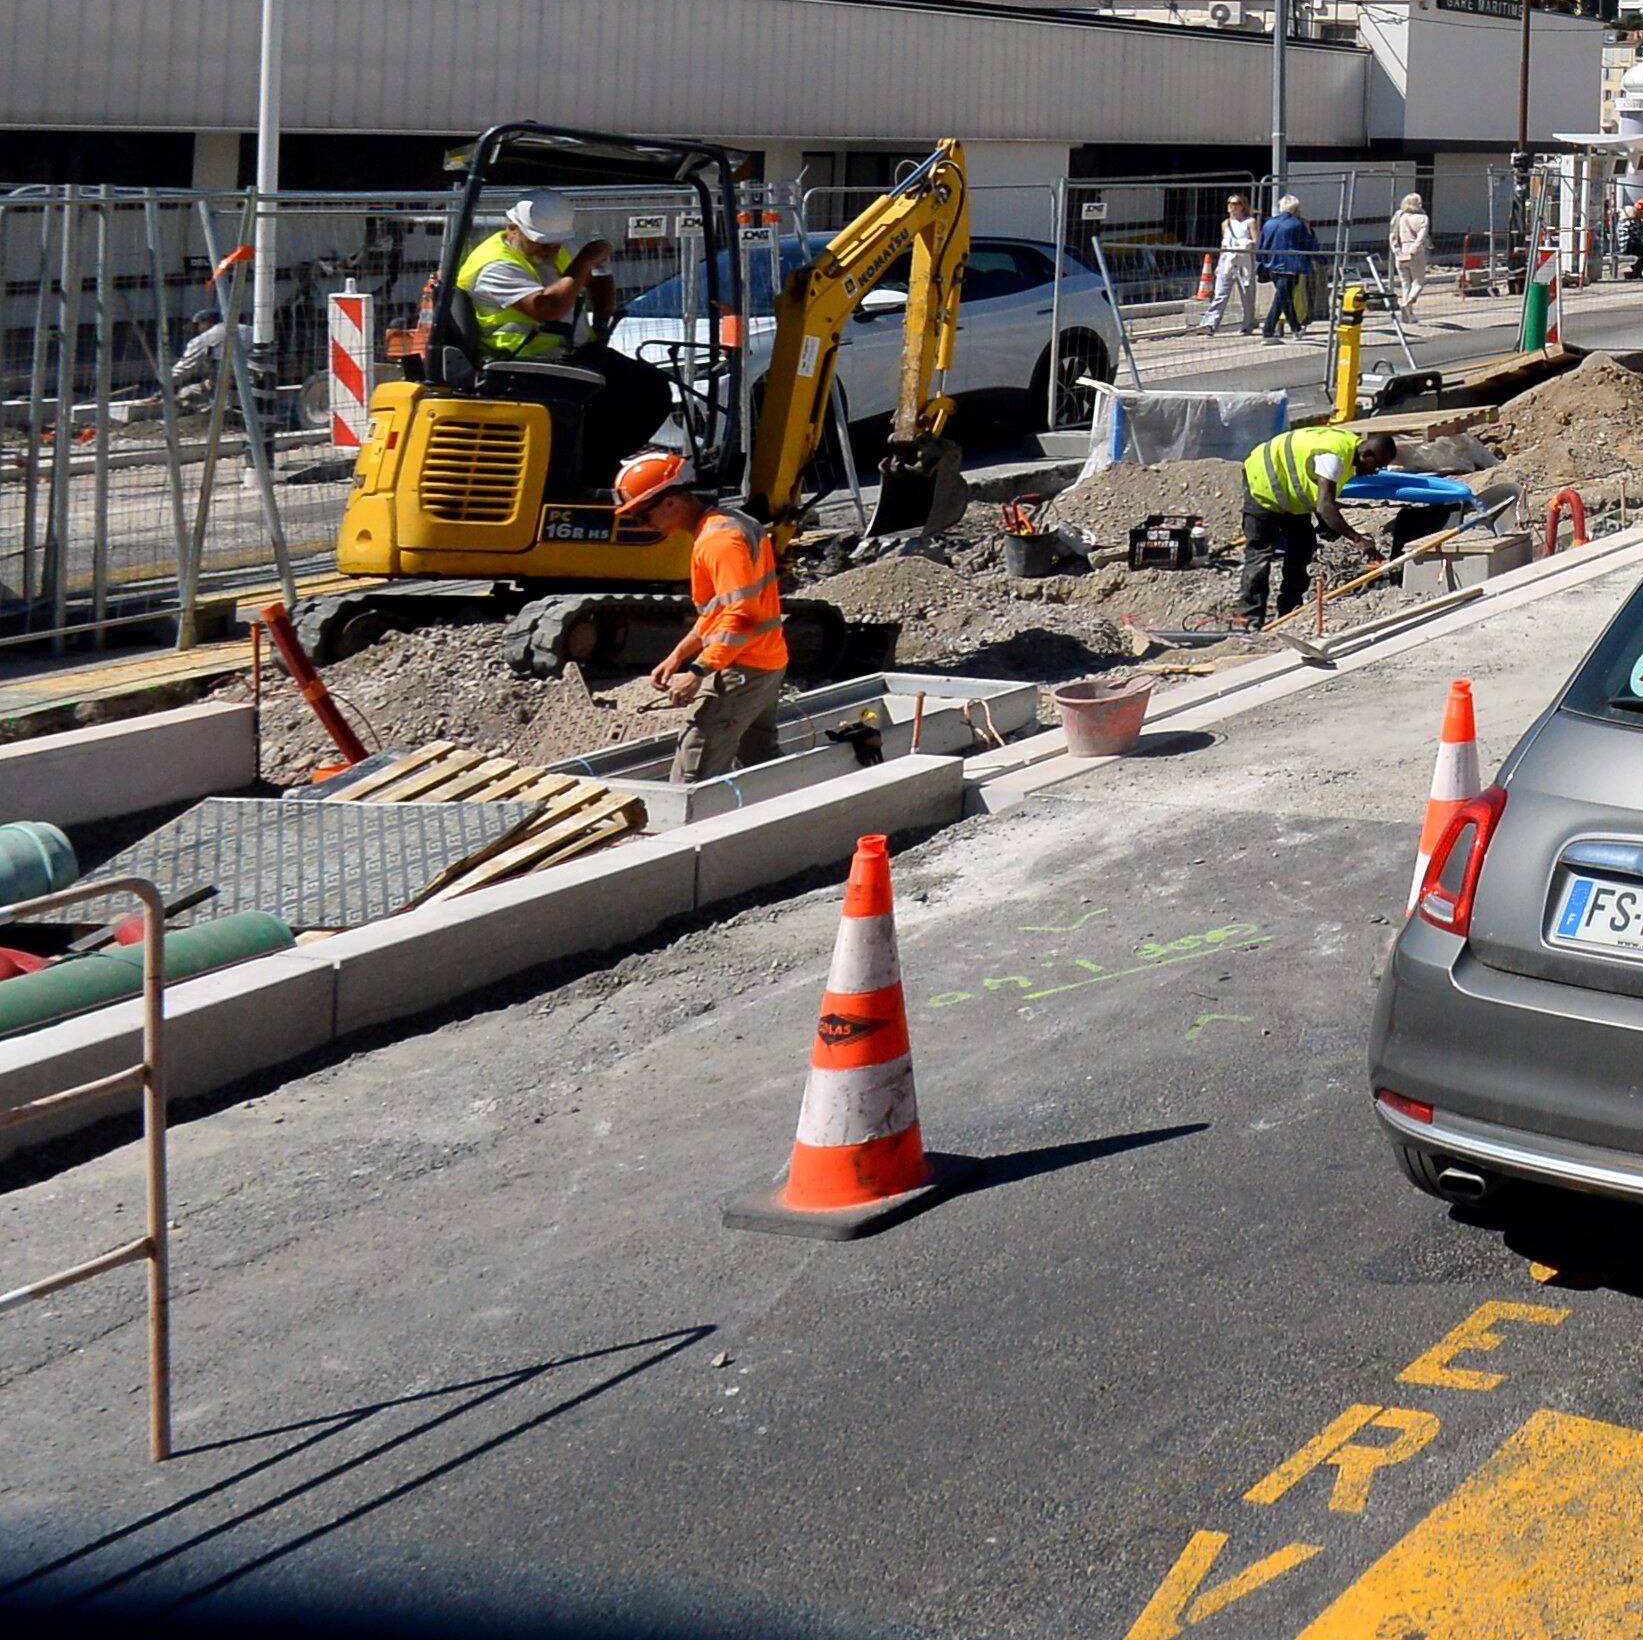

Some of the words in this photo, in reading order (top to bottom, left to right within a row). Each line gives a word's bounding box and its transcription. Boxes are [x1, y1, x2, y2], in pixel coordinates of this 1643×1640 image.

[681, 217, 704, 229] JCM
[857, 227, 909, 288] KOMATSU
[548, 510, 573, 522] PC
[545, 523, 585, 540] 16R
[588, 529, 610, 540] HS
